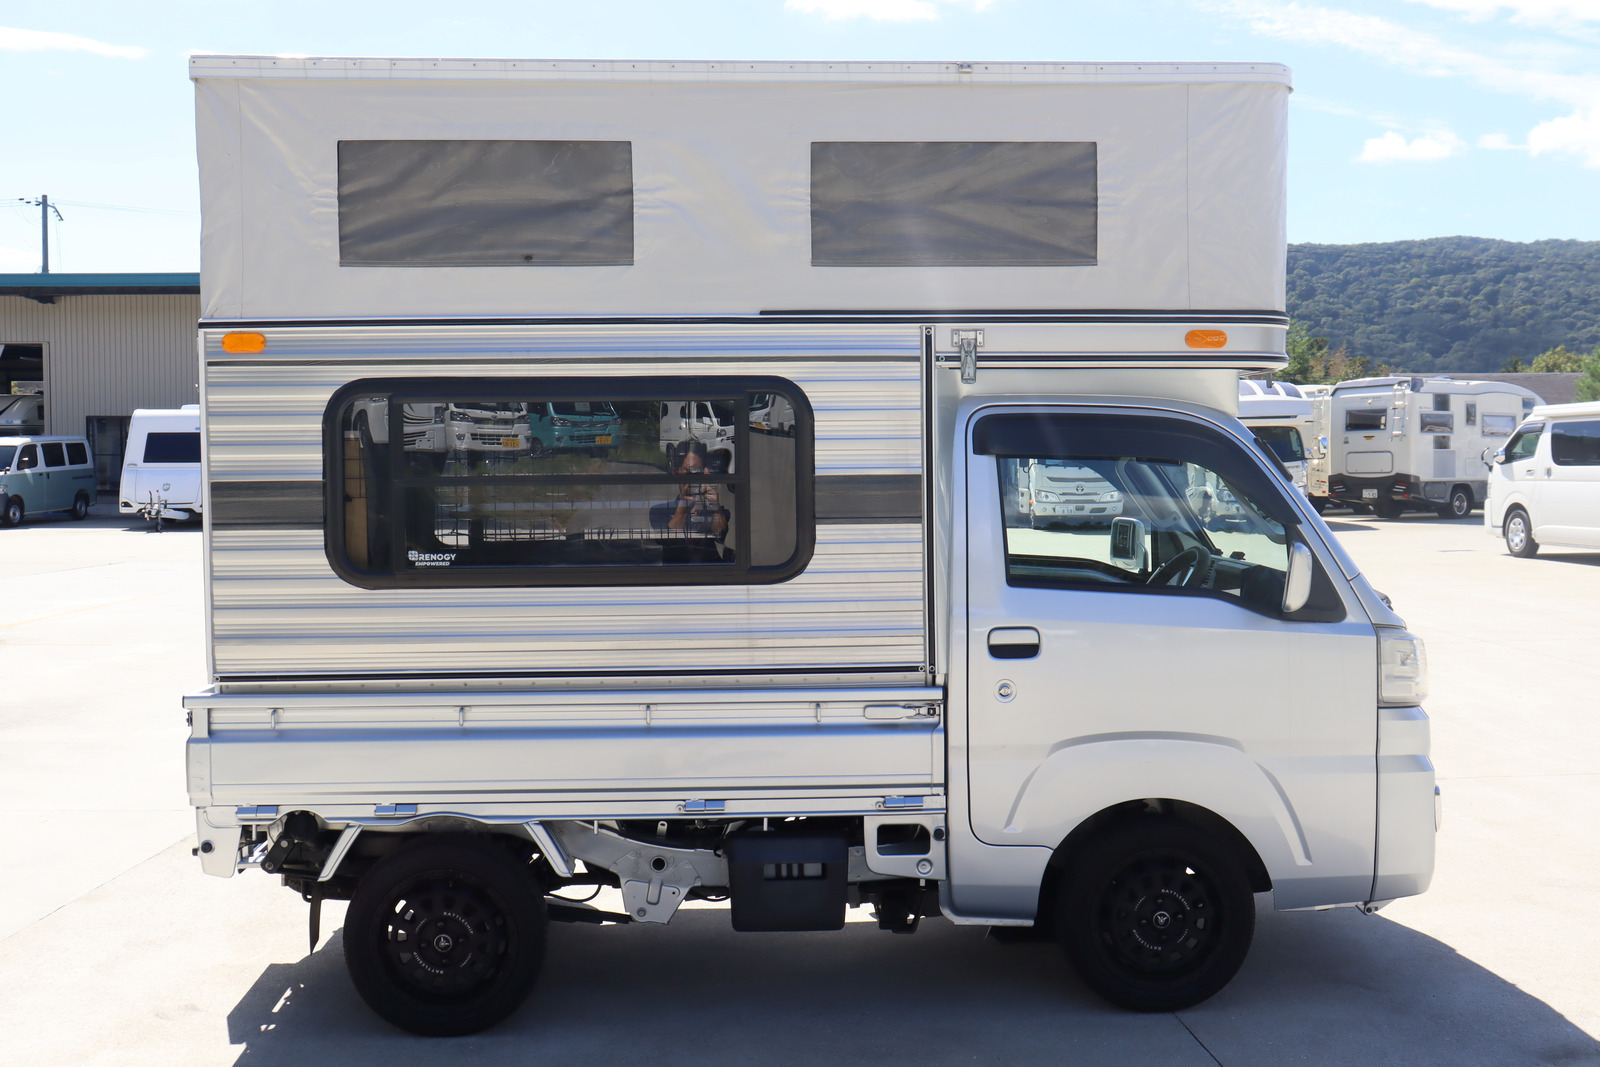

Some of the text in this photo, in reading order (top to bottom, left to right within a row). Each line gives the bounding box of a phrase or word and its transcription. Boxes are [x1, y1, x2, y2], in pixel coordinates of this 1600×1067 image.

[418, 553, 456, 561] RENOGY
[1161, 888, 1190, 910] BATTLESHIP
[443, 911, 474, 935] BATTLESHIP
